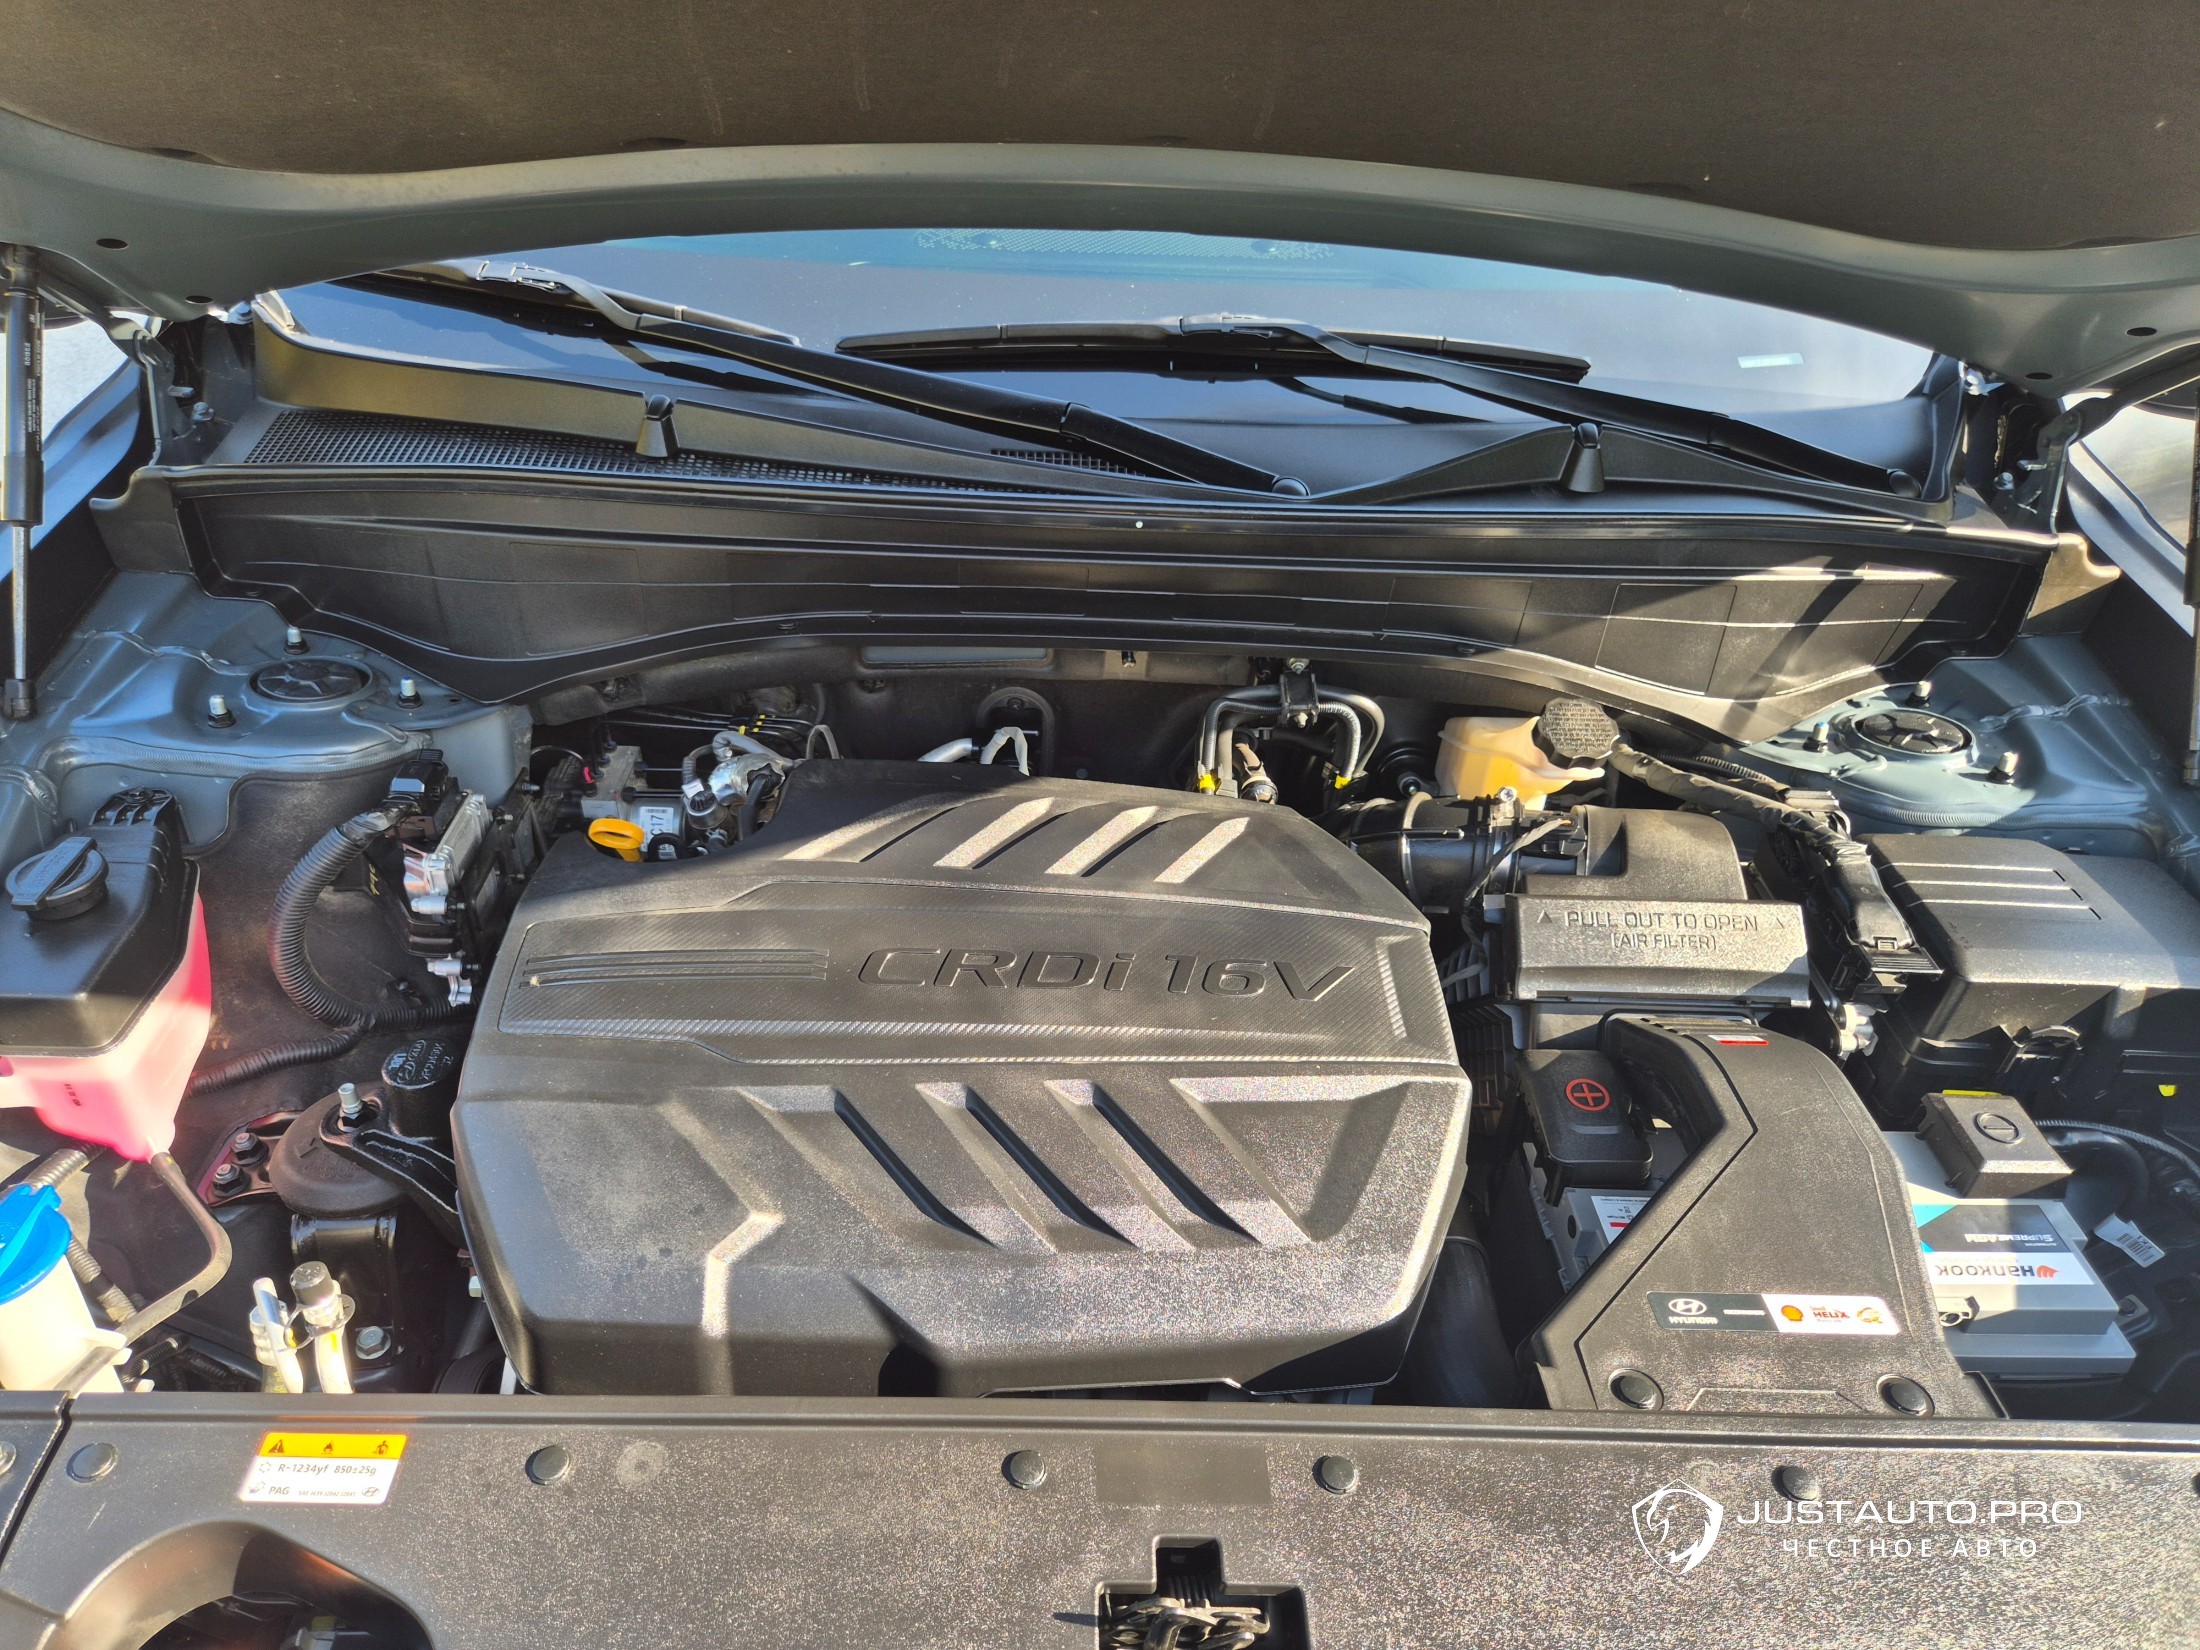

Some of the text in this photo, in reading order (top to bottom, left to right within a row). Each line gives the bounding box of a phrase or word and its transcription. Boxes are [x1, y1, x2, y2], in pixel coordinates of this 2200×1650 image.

[1564, 911, 1758, 932] PULL OUT TO OPEN
[1653, 934, 1717, 951] FILTER)
[857, 947, 1356, 1002] CRDi 16V
[1812, 1308, 1850, 1319] HELIX
[1668, 1316, 1718, 1325] HYUNDAI
[278, 1463, 377, 1476] R-1234yf 850±25g
[269, 1486, 291, 1495] PAG
